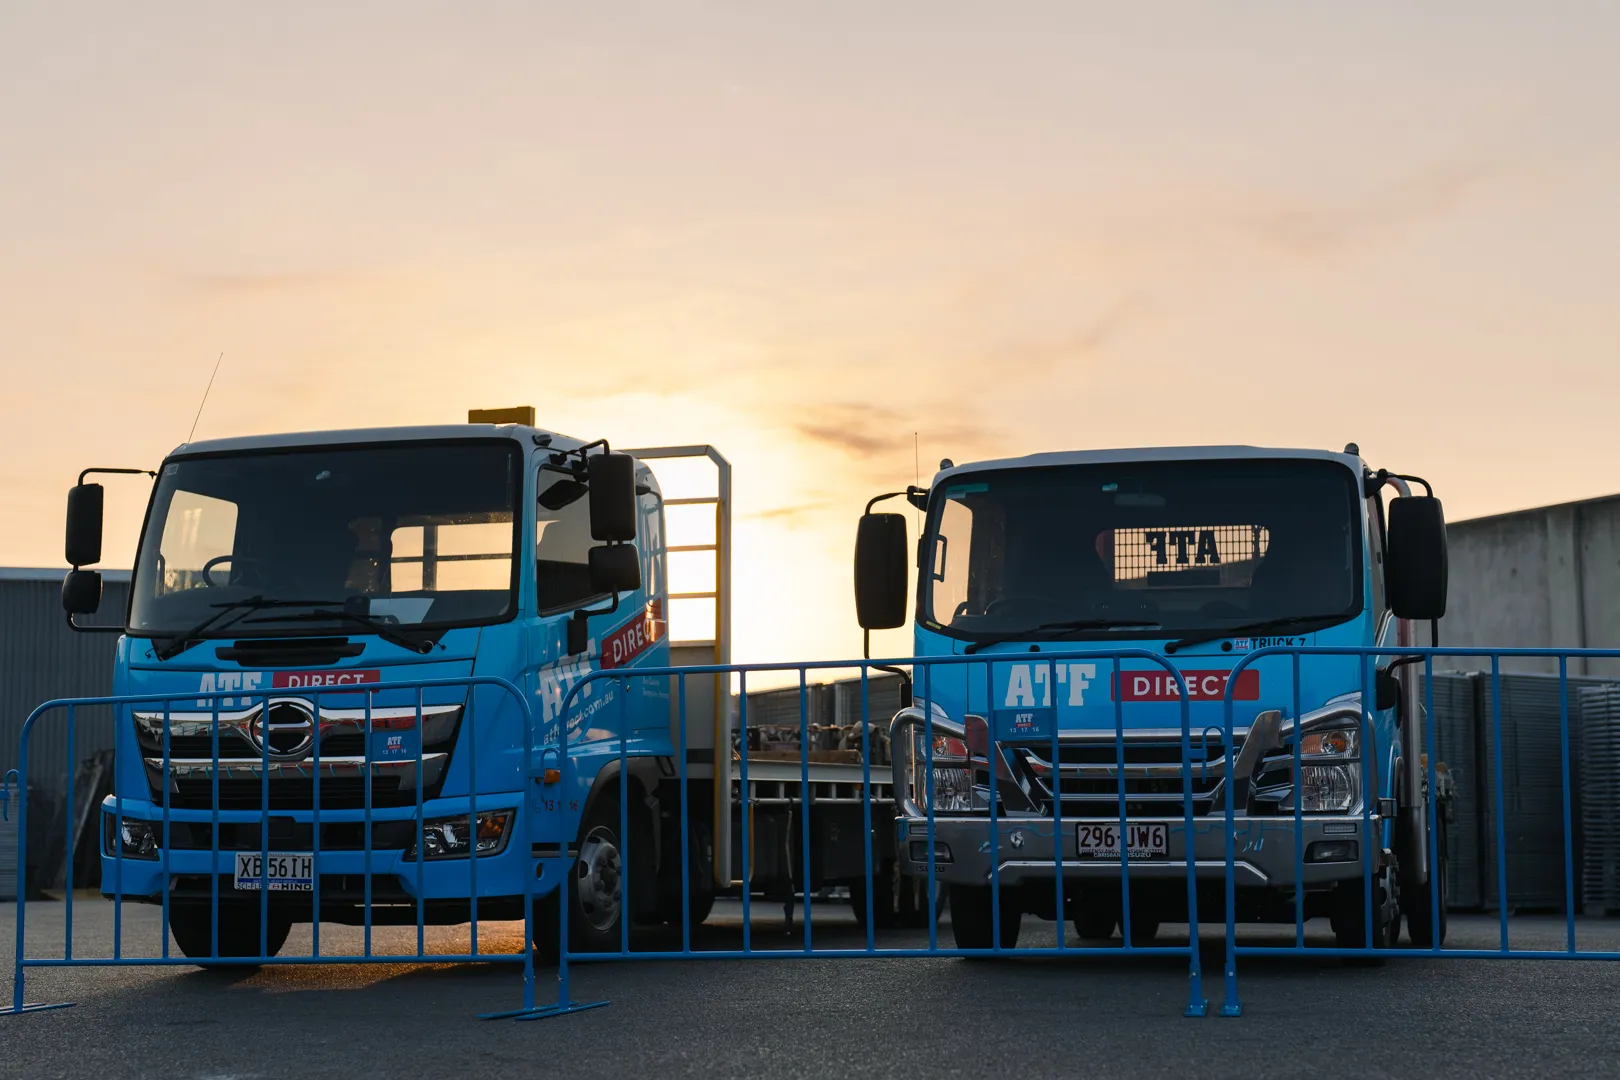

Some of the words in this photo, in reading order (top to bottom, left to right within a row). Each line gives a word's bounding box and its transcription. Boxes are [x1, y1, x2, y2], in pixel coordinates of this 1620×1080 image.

[613, 618, 657, 664] DIREC
[1250, 638, 1294, 650] TRUCK
[1298, 638, 1306, 647] 7
[289, 674, 366, 689] DIRECT
[538, 637, 597, 724] ATF
[1005, 664, 1096, 707] ATF
[197, 671, 262, 708] ATF
[1015, 713, 1034, 723] ATF
[387, 736, 402, 745] ATF
[544, 799, 554, 812] 13
